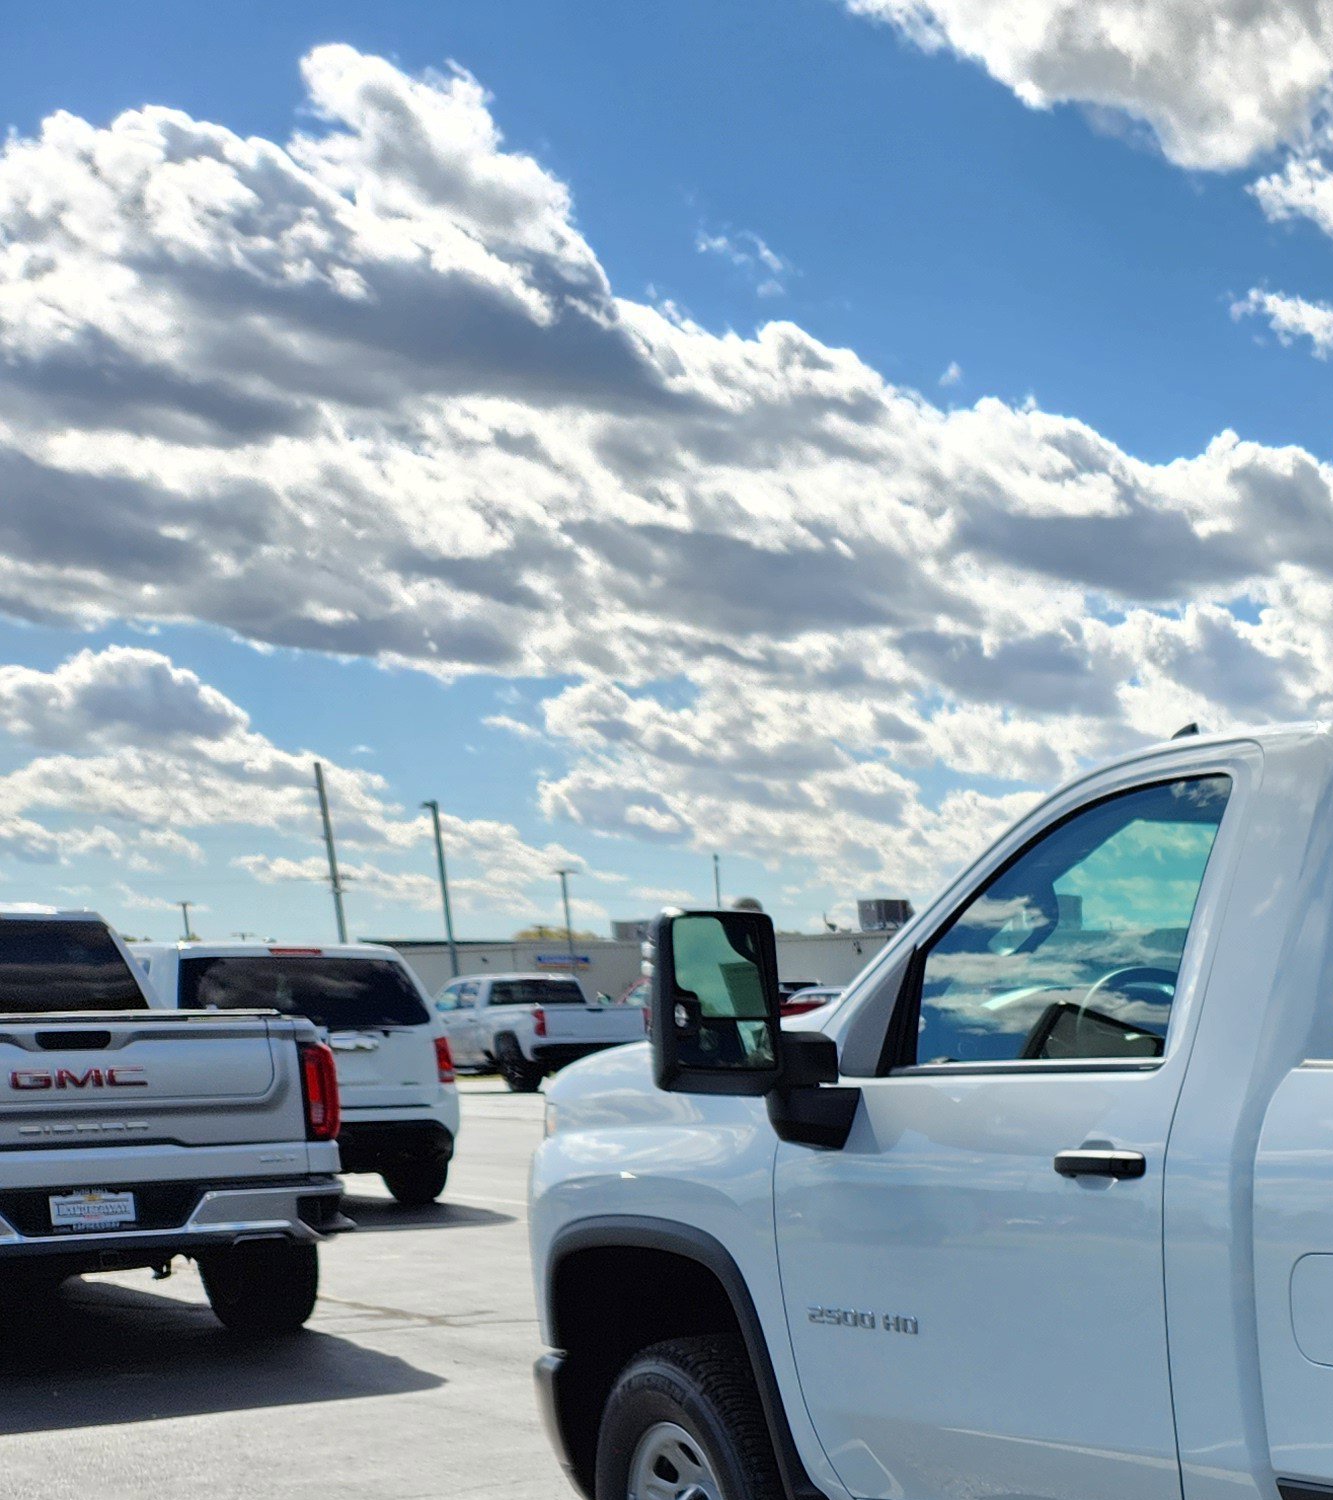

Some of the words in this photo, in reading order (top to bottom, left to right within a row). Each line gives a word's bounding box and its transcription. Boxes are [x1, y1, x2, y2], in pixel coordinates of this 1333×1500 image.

[9, 1065, 148, 1090] GMC
[808, 1305, 875, 1329] 2500
[882, 1313, 919, 1335] HD
